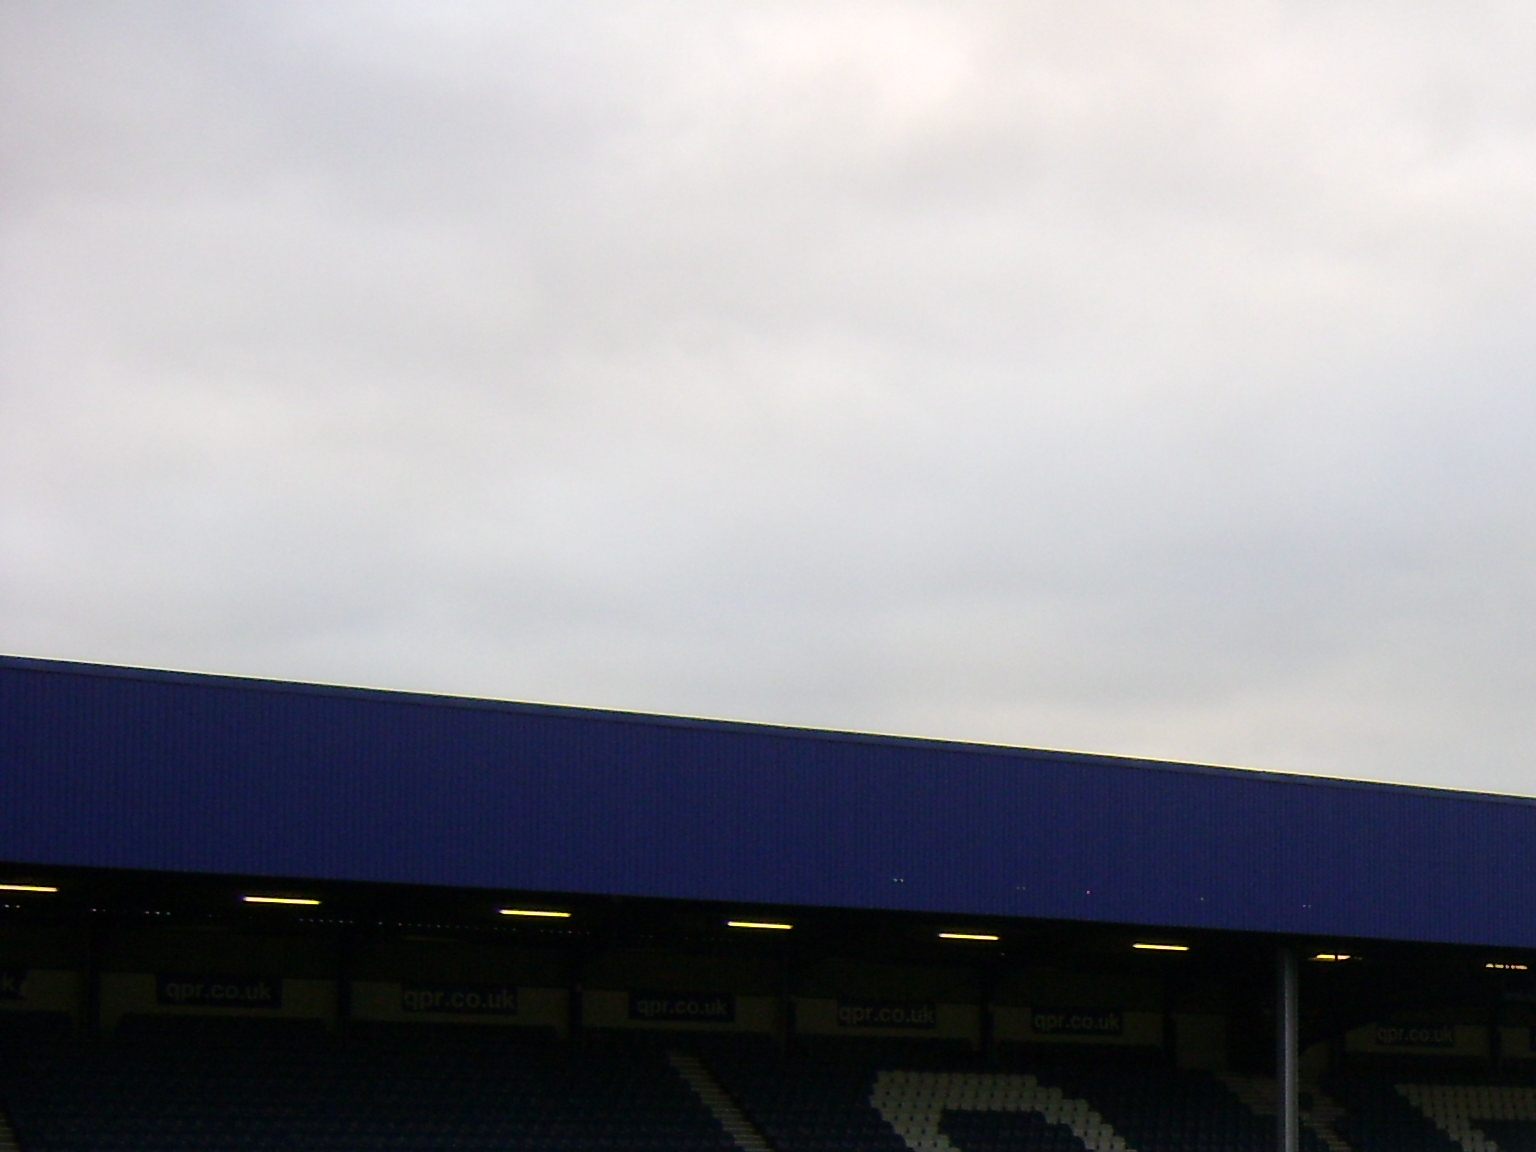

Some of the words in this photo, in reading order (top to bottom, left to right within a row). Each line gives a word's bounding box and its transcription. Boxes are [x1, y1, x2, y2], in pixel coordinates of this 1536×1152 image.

[165, 979, 272, 1002] qpr.co.uk
[404, 987, 517, 1011] qpr.co.uk
[636, 1000, 729, 1017] qpr.co.uk
[838, 1003, 935, 1024] qpr.co.uk
[1034, 1012, 1120, 1032] qpr.co.uk
